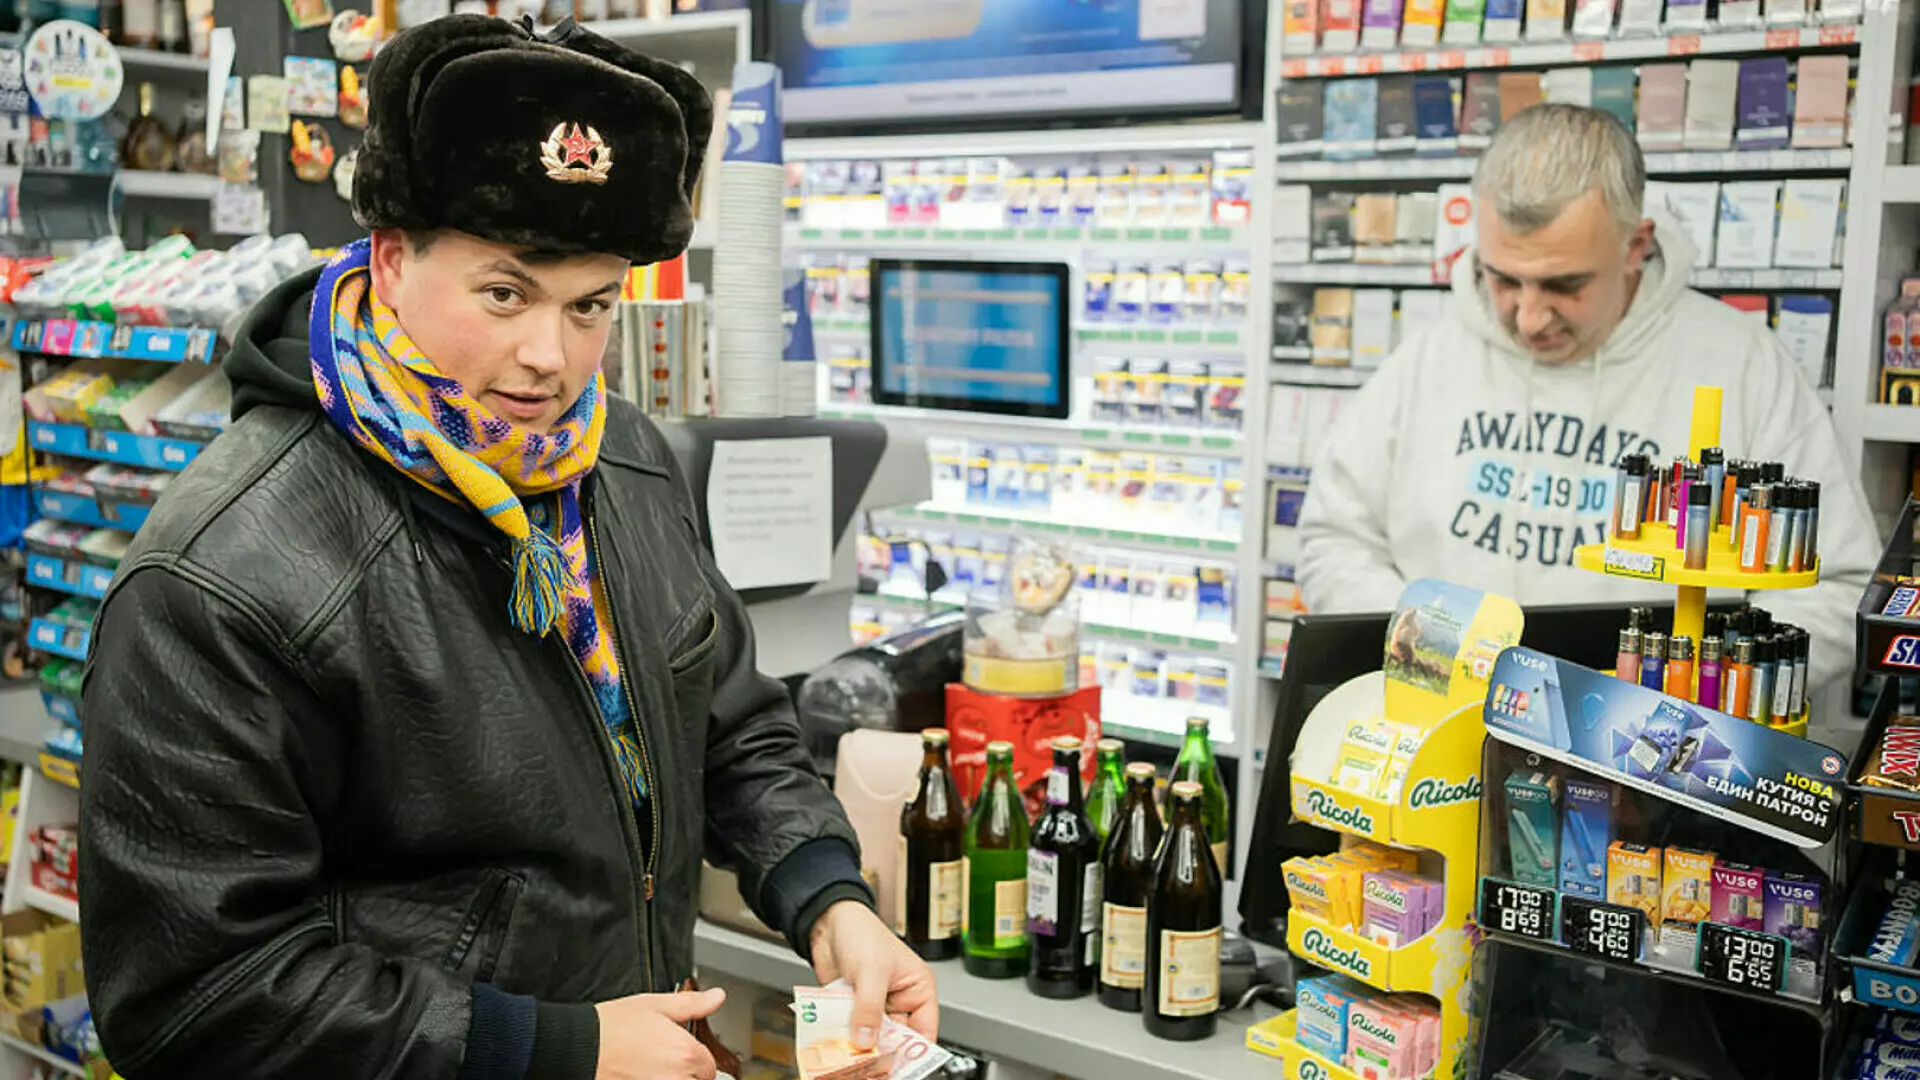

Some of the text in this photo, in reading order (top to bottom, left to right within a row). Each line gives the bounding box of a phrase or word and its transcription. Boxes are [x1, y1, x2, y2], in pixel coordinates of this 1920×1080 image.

[1756, 777, 1814, 808] КУТИЯ
[1785, 771, 1833, 799] НОВА
[1306, 789, 1373, 833] Ricola
[1707, 775, 1754, 802] ЕДИН
[1755, 793, 1828, 828] ПАТРОН
[1366, 880, 1403, 907] Ricola
[1303, 930, 1370, 977] Ricola
[1351, 1013, 1397, 1044] Ricola
